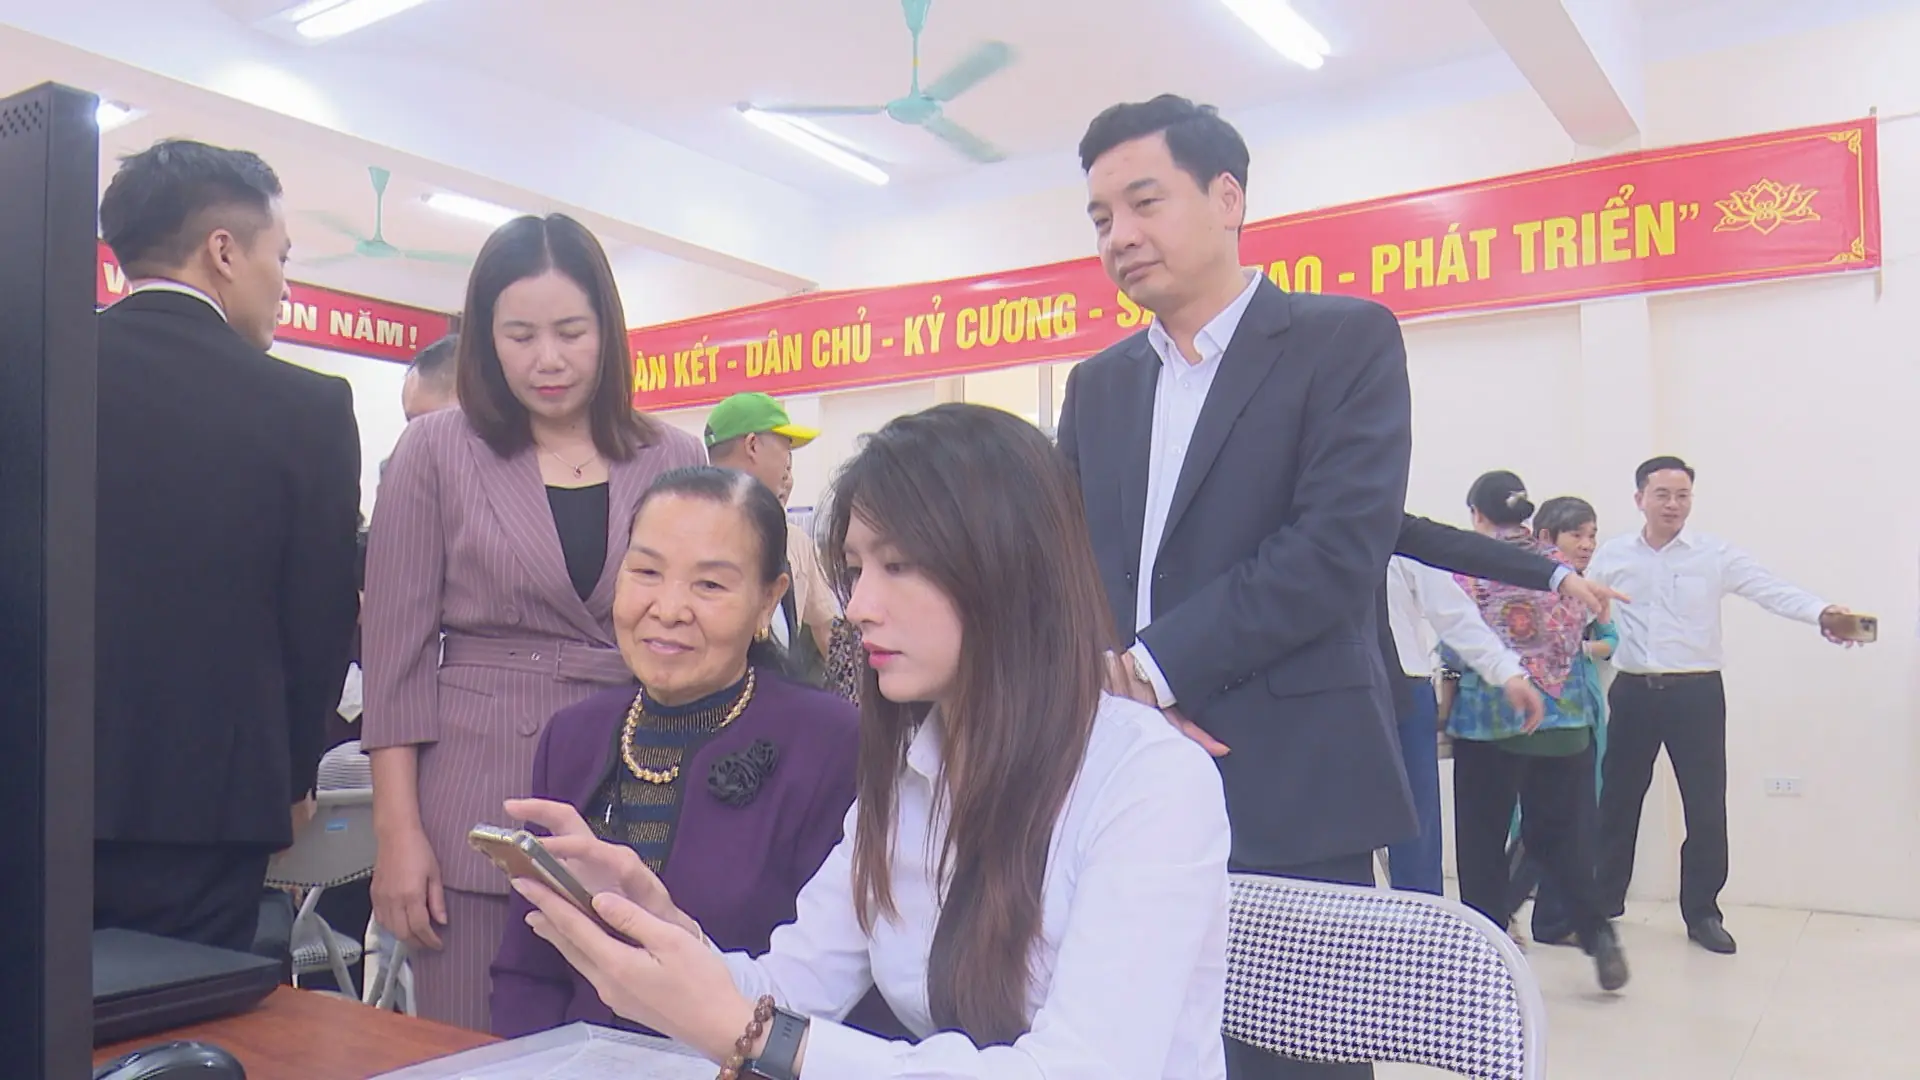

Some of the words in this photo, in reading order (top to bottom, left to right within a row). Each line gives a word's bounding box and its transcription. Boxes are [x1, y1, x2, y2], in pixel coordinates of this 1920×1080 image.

[634, 350, 667, 393] ÀN
[674, 335, 720, 388] KẾT
[746, 329, 802, 378] DÂN
[811, 306, 872, 369] CHỦ
[904, 295, 945, 356] KỶ
[956, 293, 1077, 349] CƯƠNG
[1257, 255, 1322, 295] AO
[1372, 222, 1497, 295] PHÁT
